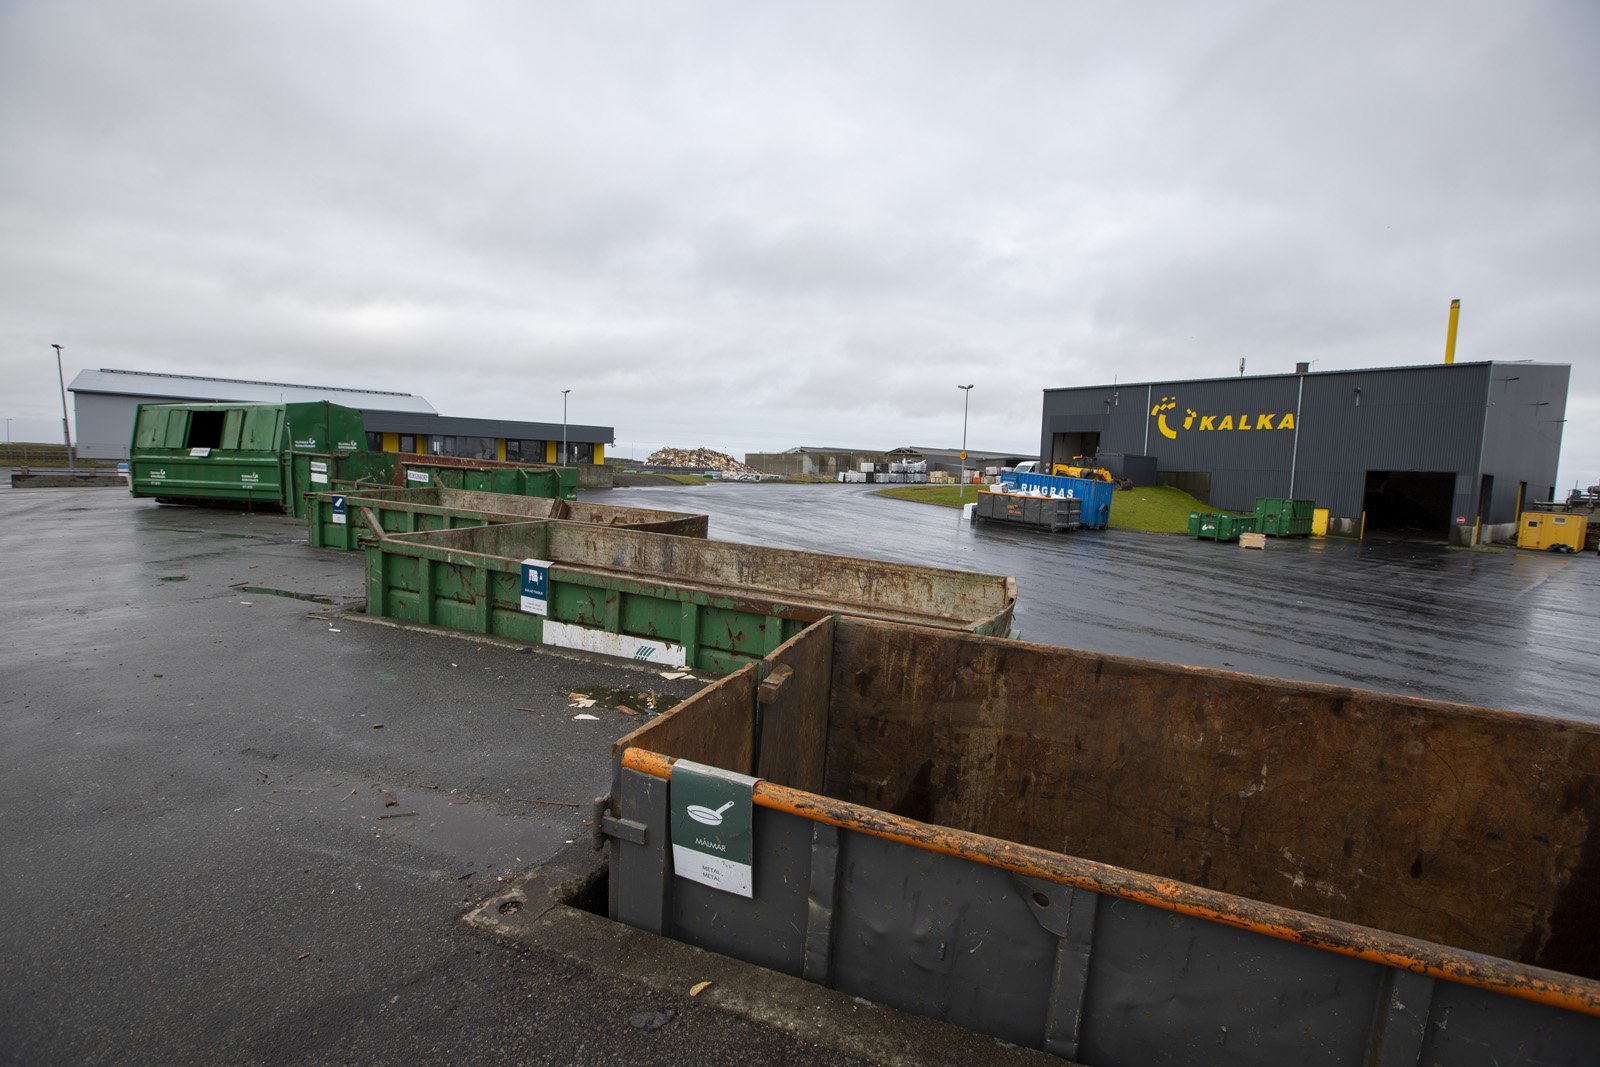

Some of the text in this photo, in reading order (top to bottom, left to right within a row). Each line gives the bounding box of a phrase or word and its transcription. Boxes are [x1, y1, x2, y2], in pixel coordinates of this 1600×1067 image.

[1199, 413, 1296, 431] KALKA
[695, 838, 727, 852] MÁLMAR
[702, 865, 721, 875] METAL
[702, 872, 721, 882] METAL
